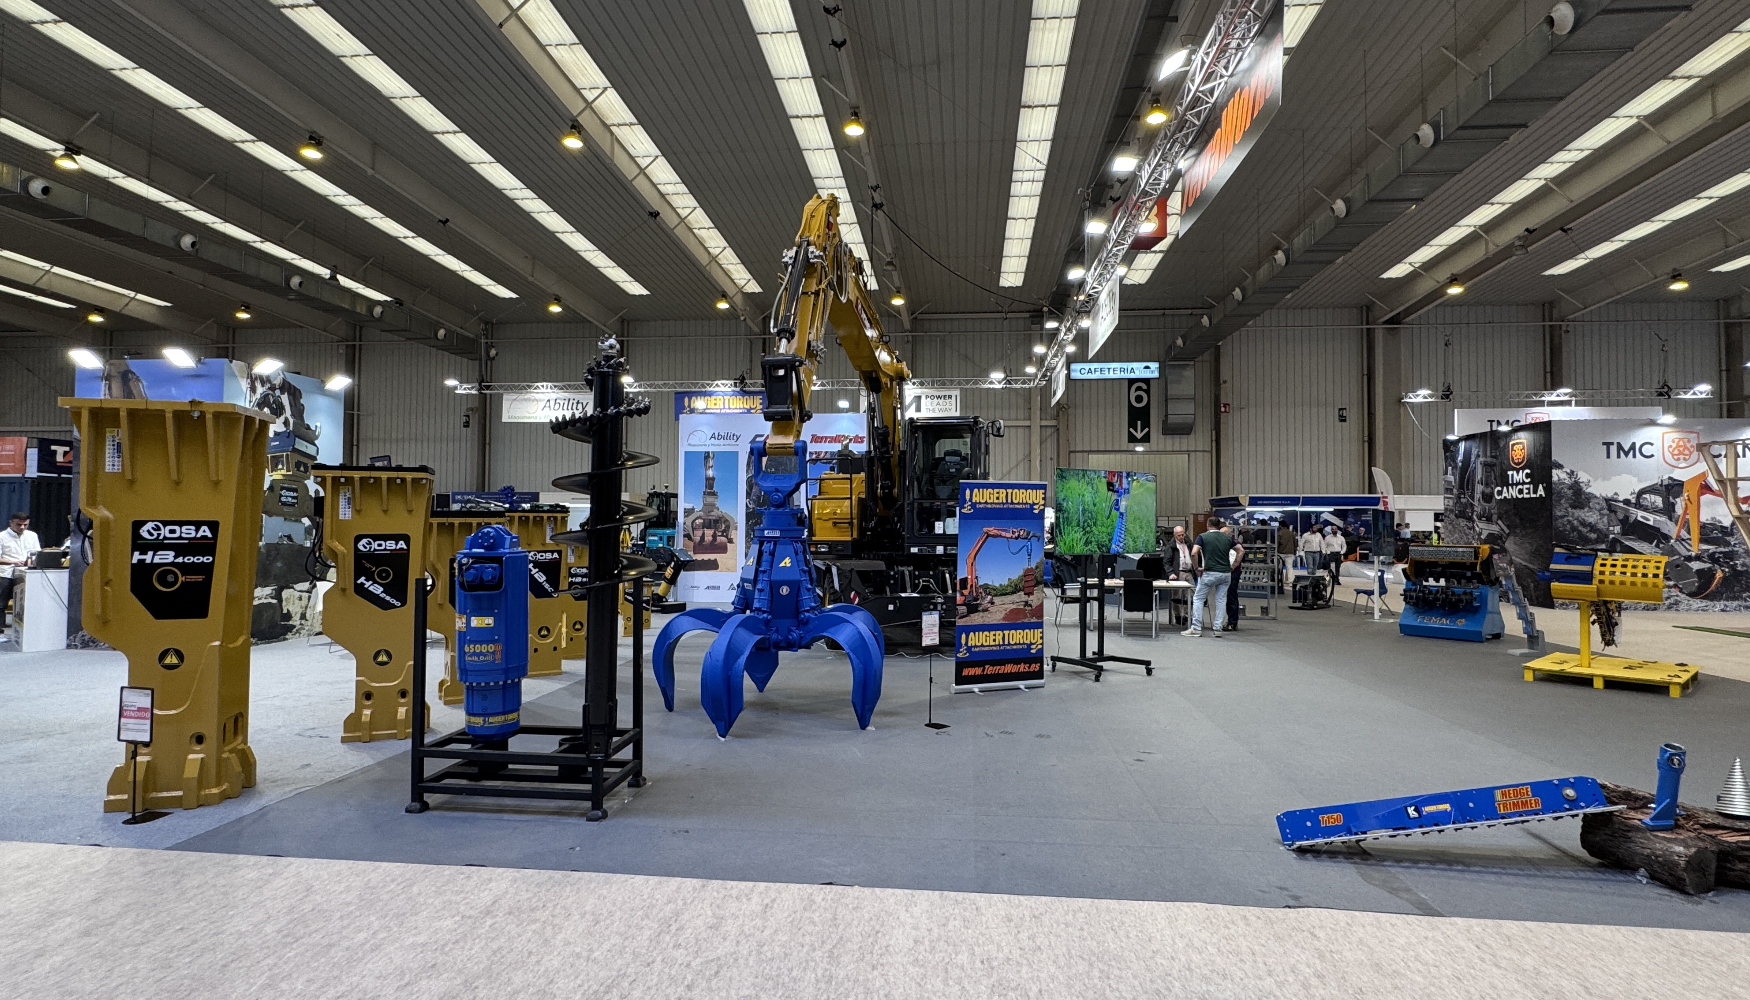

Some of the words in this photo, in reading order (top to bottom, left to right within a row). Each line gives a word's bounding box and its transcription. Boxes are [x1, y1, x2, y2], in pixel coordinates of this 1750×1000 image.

[1079, 365, 1136, 376] CAFETERÍA
[1129, 381, 1149, 408] 6
[541, 398, 590, 414] Ability
[708, 432, 742, 443] Ability
[809, 434, 866, 444] TerraWrks
[1601, 441, 1655, 459] TMC
[1507, 469, 1531, 484] TMC
[972, 488, 1006, 503] AUGER
[1006, 489, 1045, 504] TORQUE
[1494, 484, 1546, 500] CANCELA
[164, 525, 213, 538] OSA
[374, 540, 408, 550] OSA
[538, 551, 560, 560] OSA
[968, 631, 1003, 646] AUGER
[1003, 629, 1043, 645] TORQUE
[961, 662, 1041, 677] www.TerraWorks.es
[122, 710, 151, 718] VENDIDO
[1500, 785, 1531, 800] HEDGE
[1495, 797, 1541, 813] TRIMMER
[1319, 813, 1344, 826] T150
